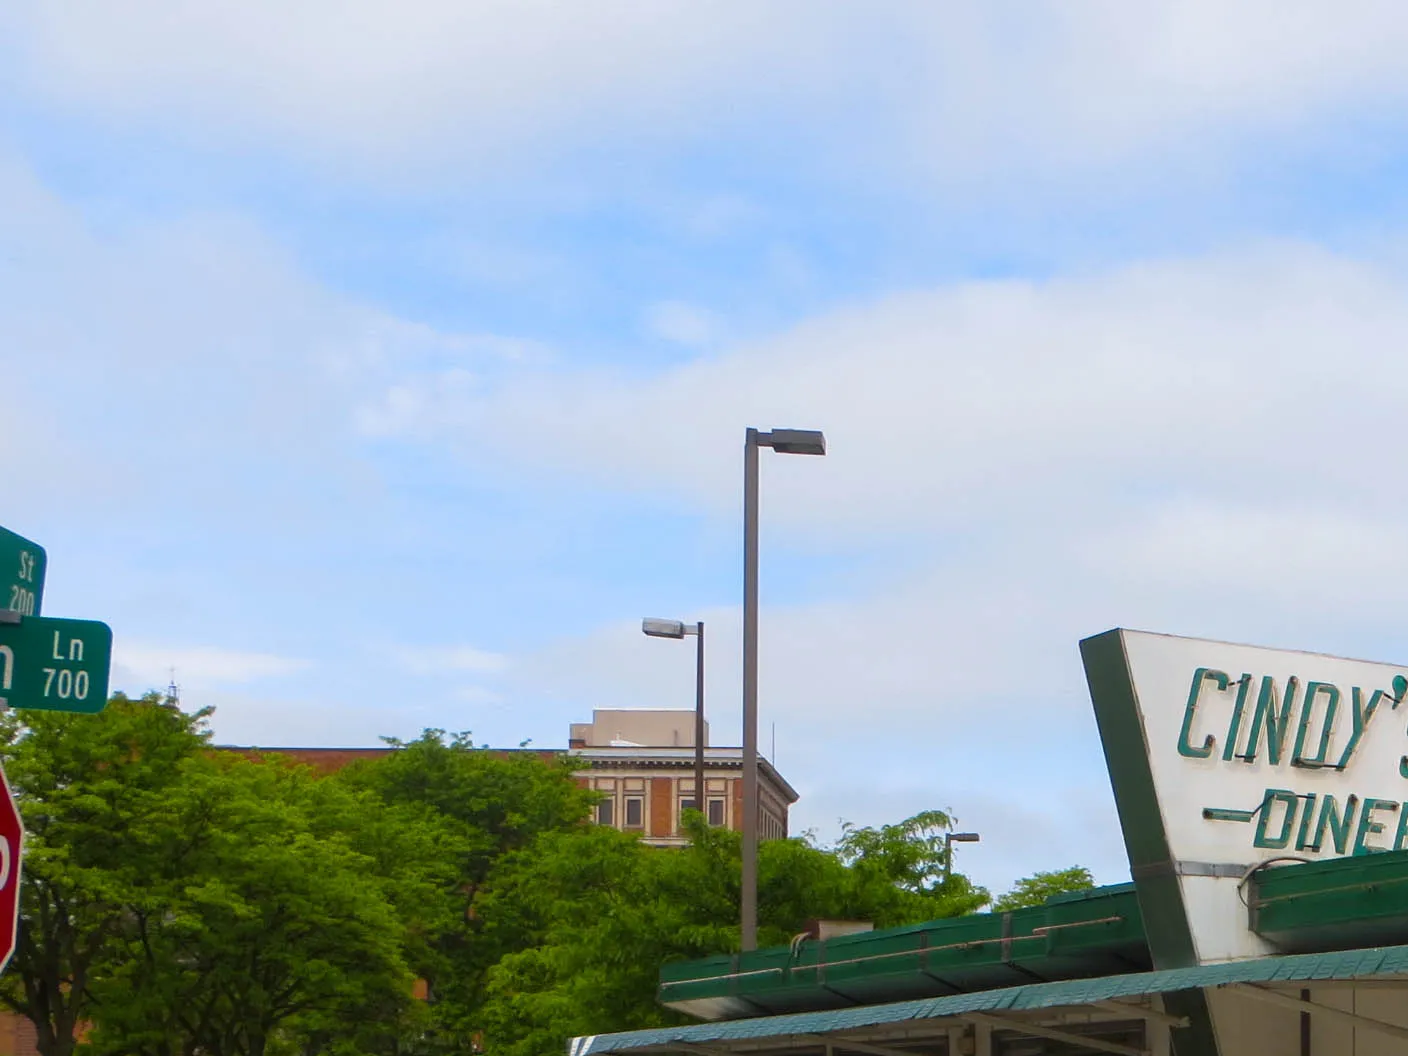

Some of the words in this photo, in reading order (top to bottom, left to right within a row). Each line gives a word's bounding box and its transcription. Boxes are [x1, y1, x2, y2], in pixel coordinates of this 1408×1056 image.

[19, 551, 34, 582] St
[10, 586, 35, 616] 200
[53, 631, 84, 661] Ln
[43, 668, 90, 700] 700
